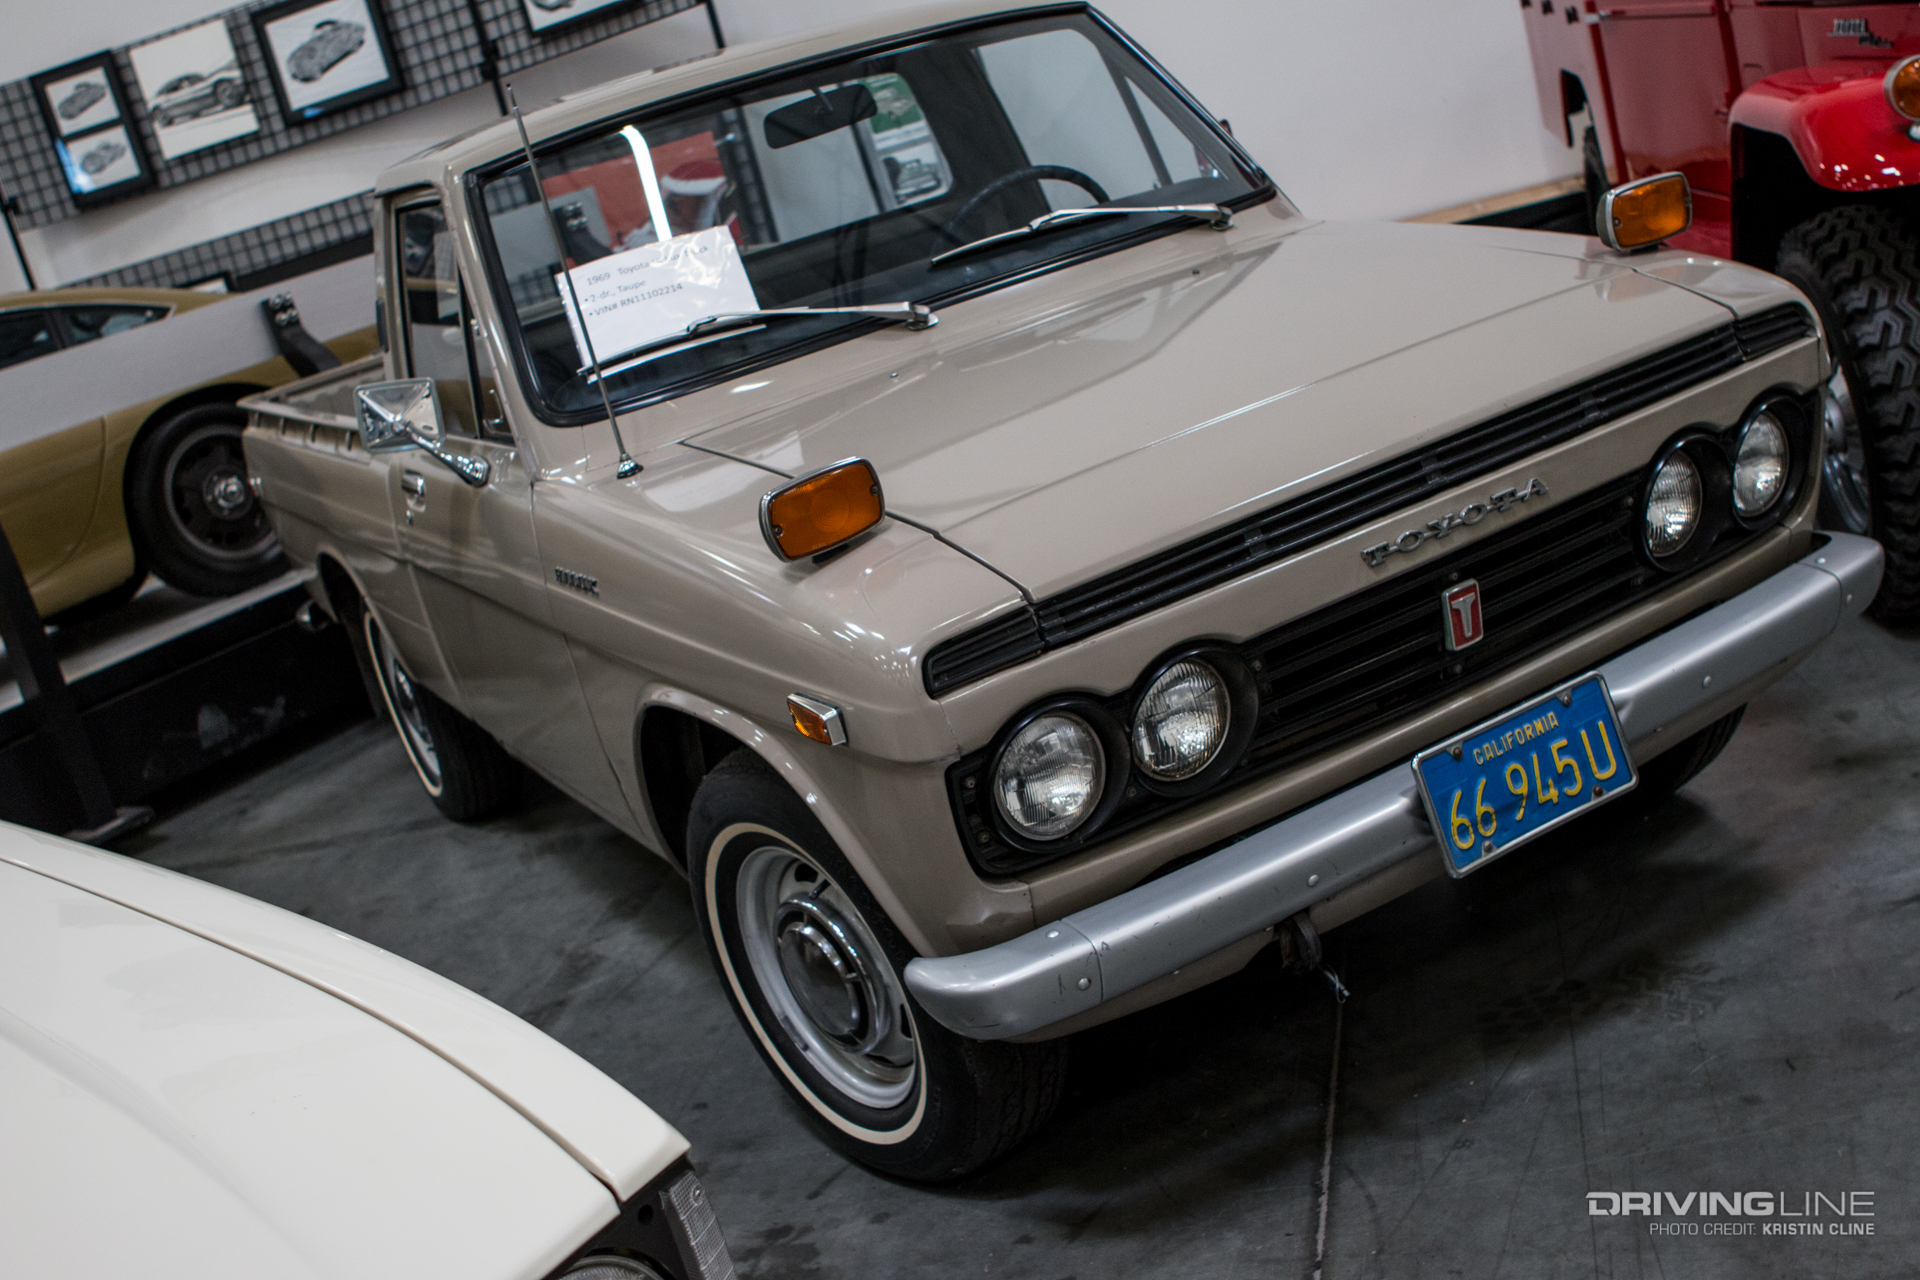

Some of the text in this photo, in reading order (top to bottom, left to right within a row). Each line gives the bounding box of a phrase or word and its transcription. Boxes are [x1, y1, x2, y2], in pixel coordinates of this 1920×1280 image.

[586, 272, 611, 286] 1969
[617, 261, 650, 276] Toyota
[617, 279, 647, 293] Taupe
[593, 282, 683, 316] VIN# RN11102214
[1360, 478, 1549, 568] TOYOTA
[1473, 712, 1559, 766] CALIFORNIA
[1450, 777, 1498, 850] 66
